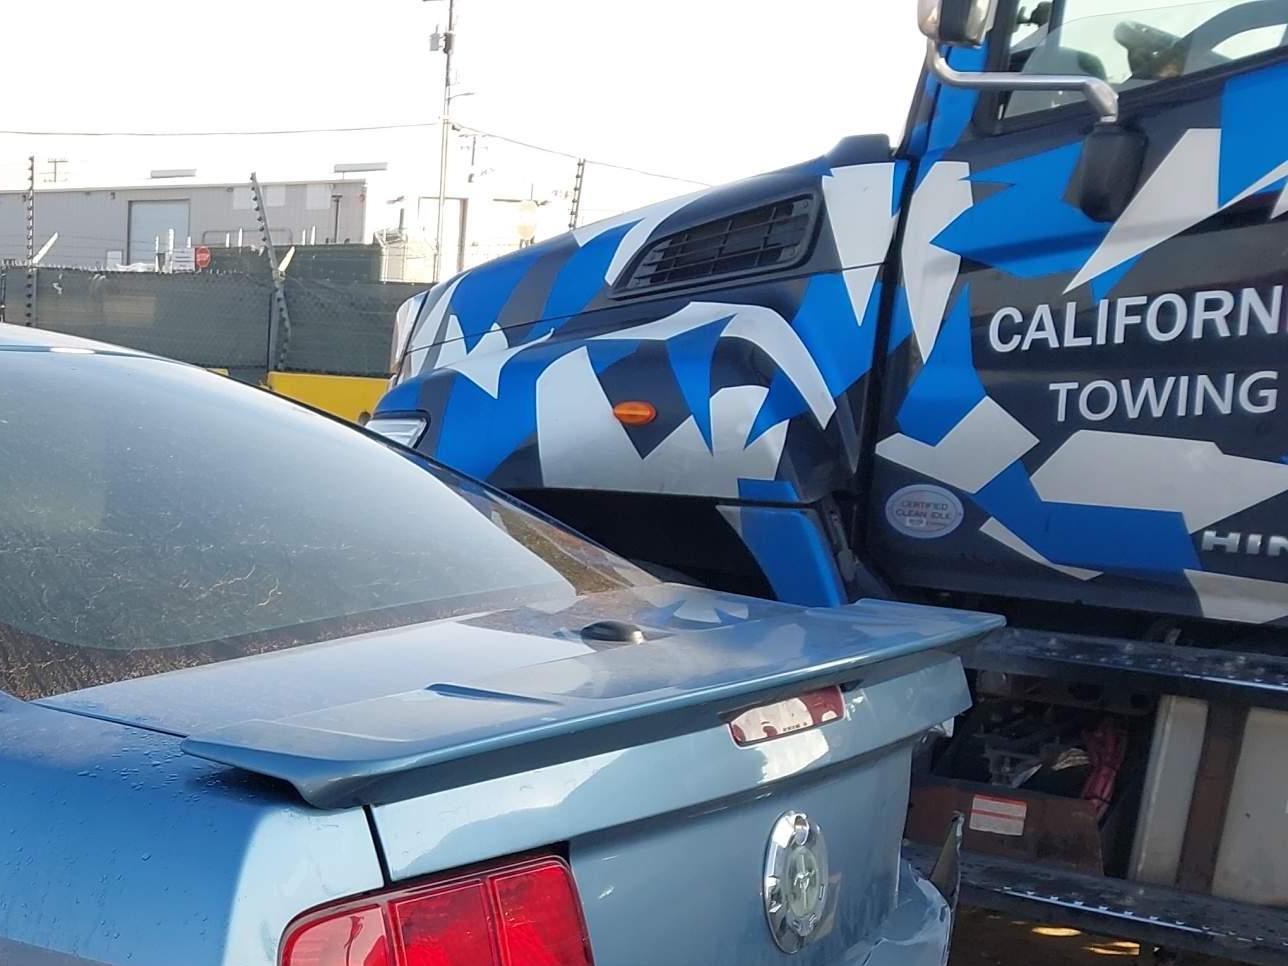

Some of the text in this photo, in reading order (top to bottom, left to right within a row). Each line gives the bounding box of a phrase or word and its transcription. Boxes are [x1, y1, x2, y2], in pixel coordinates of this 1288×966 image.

[989, 285, 1288, 352] CALIFORN
[1049, 370, 1279, 422] TOWING
[895, 508, 928, 519] CLEAN
